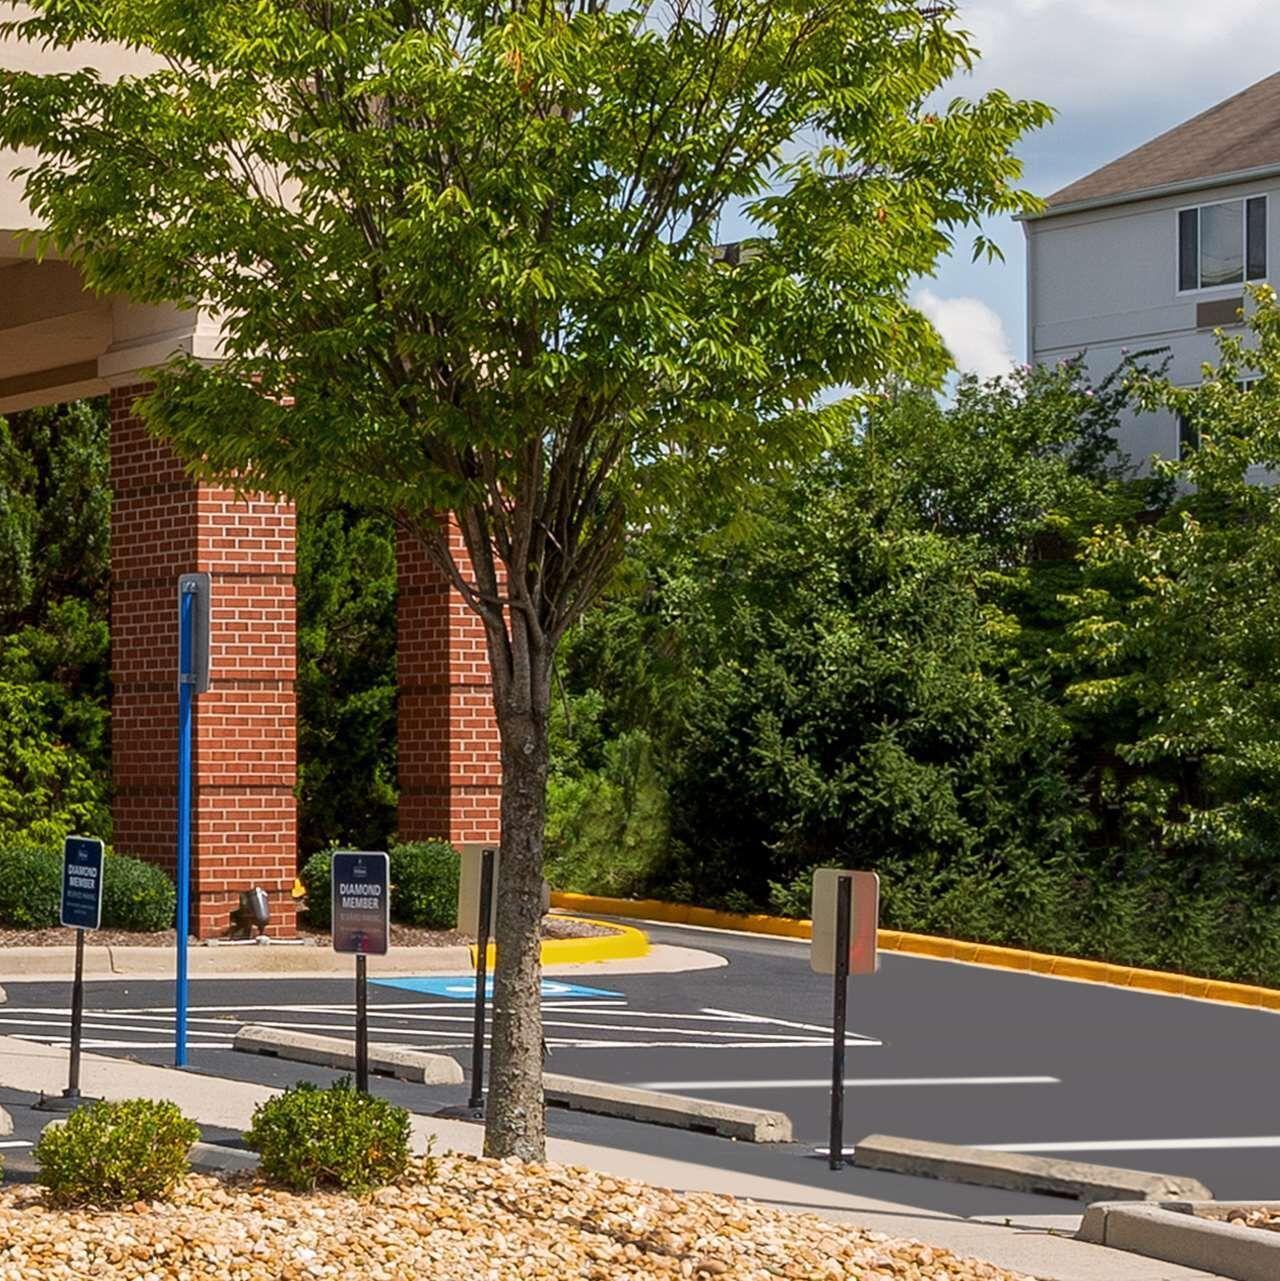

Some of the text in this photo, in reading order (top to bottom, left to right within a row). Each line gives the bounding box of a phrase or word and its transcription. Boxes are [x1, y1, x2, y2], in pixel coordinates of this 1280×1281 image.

[68, 864, 97, 878] DIAMOND
[69, 876, 95, 889] MEMBER
[340, 883, 381, 896] DIAMOND
[342, 897, 380, 909] MEMBER
